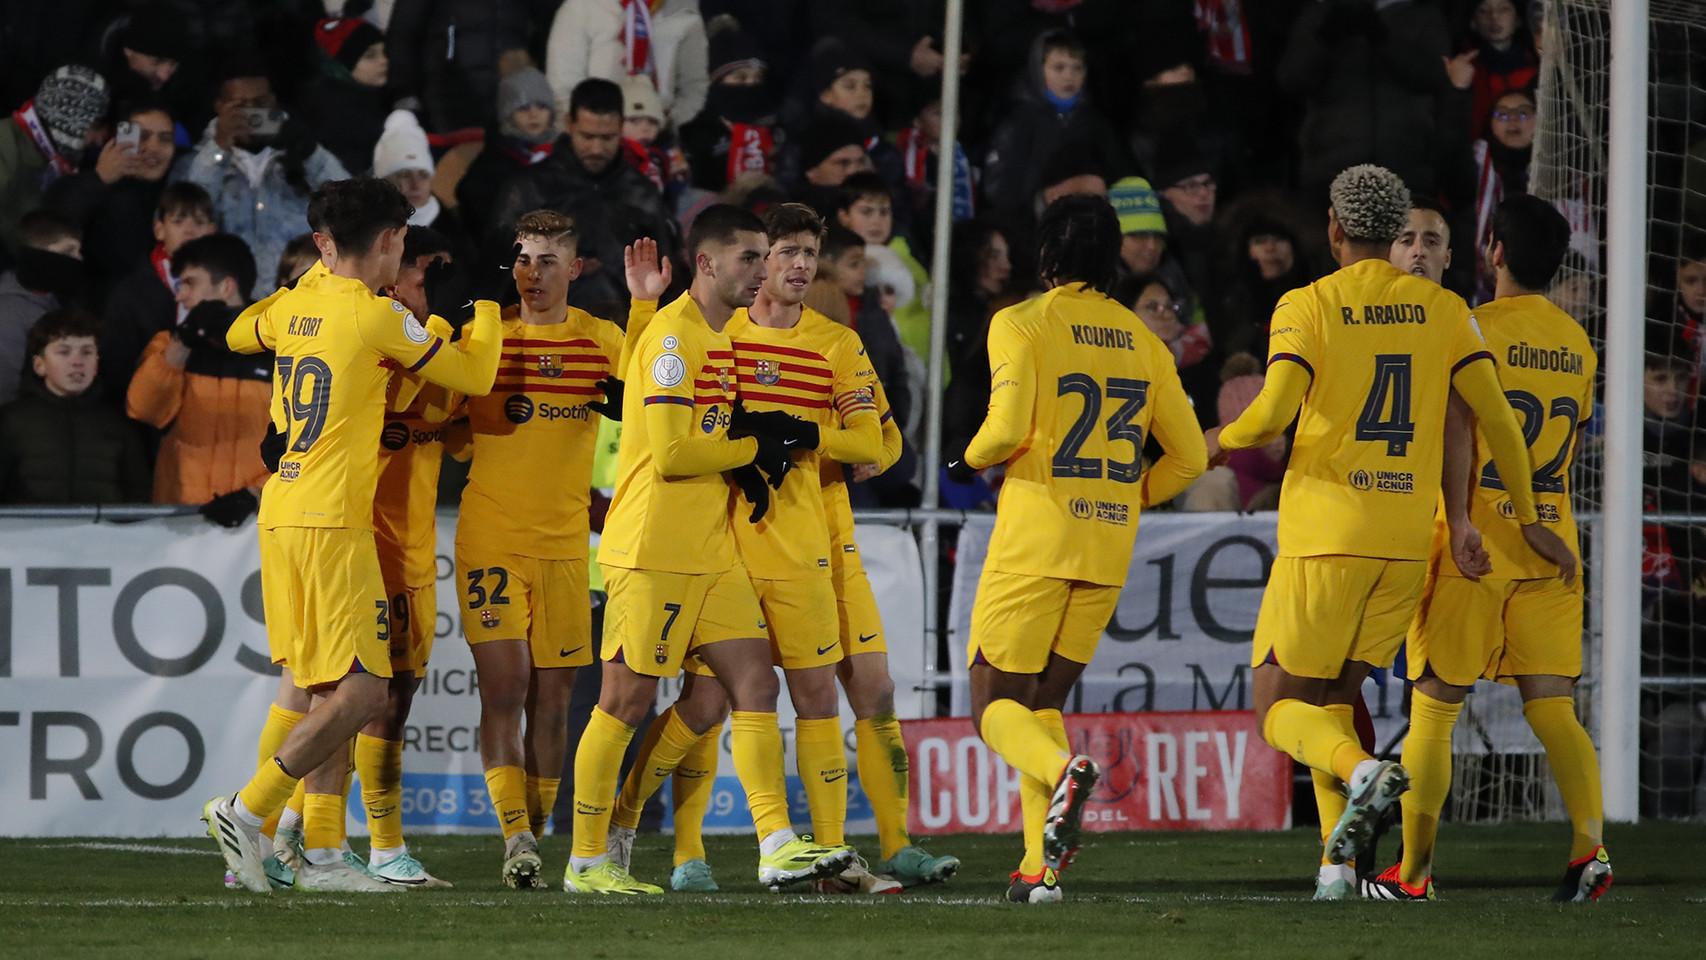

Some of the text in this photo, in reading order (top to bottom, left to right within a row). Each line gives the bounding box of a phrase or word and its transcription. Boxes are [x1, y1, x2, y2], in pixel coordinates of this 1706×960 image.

[1341, 304, 1426, 325] R. ARAUJO
[1071, 324, 1136, 351] KOUNDE
[1506, 341, 1584, 376] GÜNDOĞAN
[538, 402, 592, 422] Spotify
[1355, 354, 1415, 457] 4
[411, 428, 442, 444] Spot
[1052, 372, 1150, 484] 23
[1376, 470, 1413, 482] UNHCR
[1376, 480, 1413, 491] ACNUR
[1095, 500, 1129, 514] UNHCR
[1096, 510, 1129, 523] ACNUR
[467, 566, 511, 609] 32
[0, 566, 284, 678] TOS
[661, 602, 682, 641] 7
[0, 710, 207, 801] RO
[1082, 809, 1129, 822] DEL
[1145, 730, 1249, 821] REY
